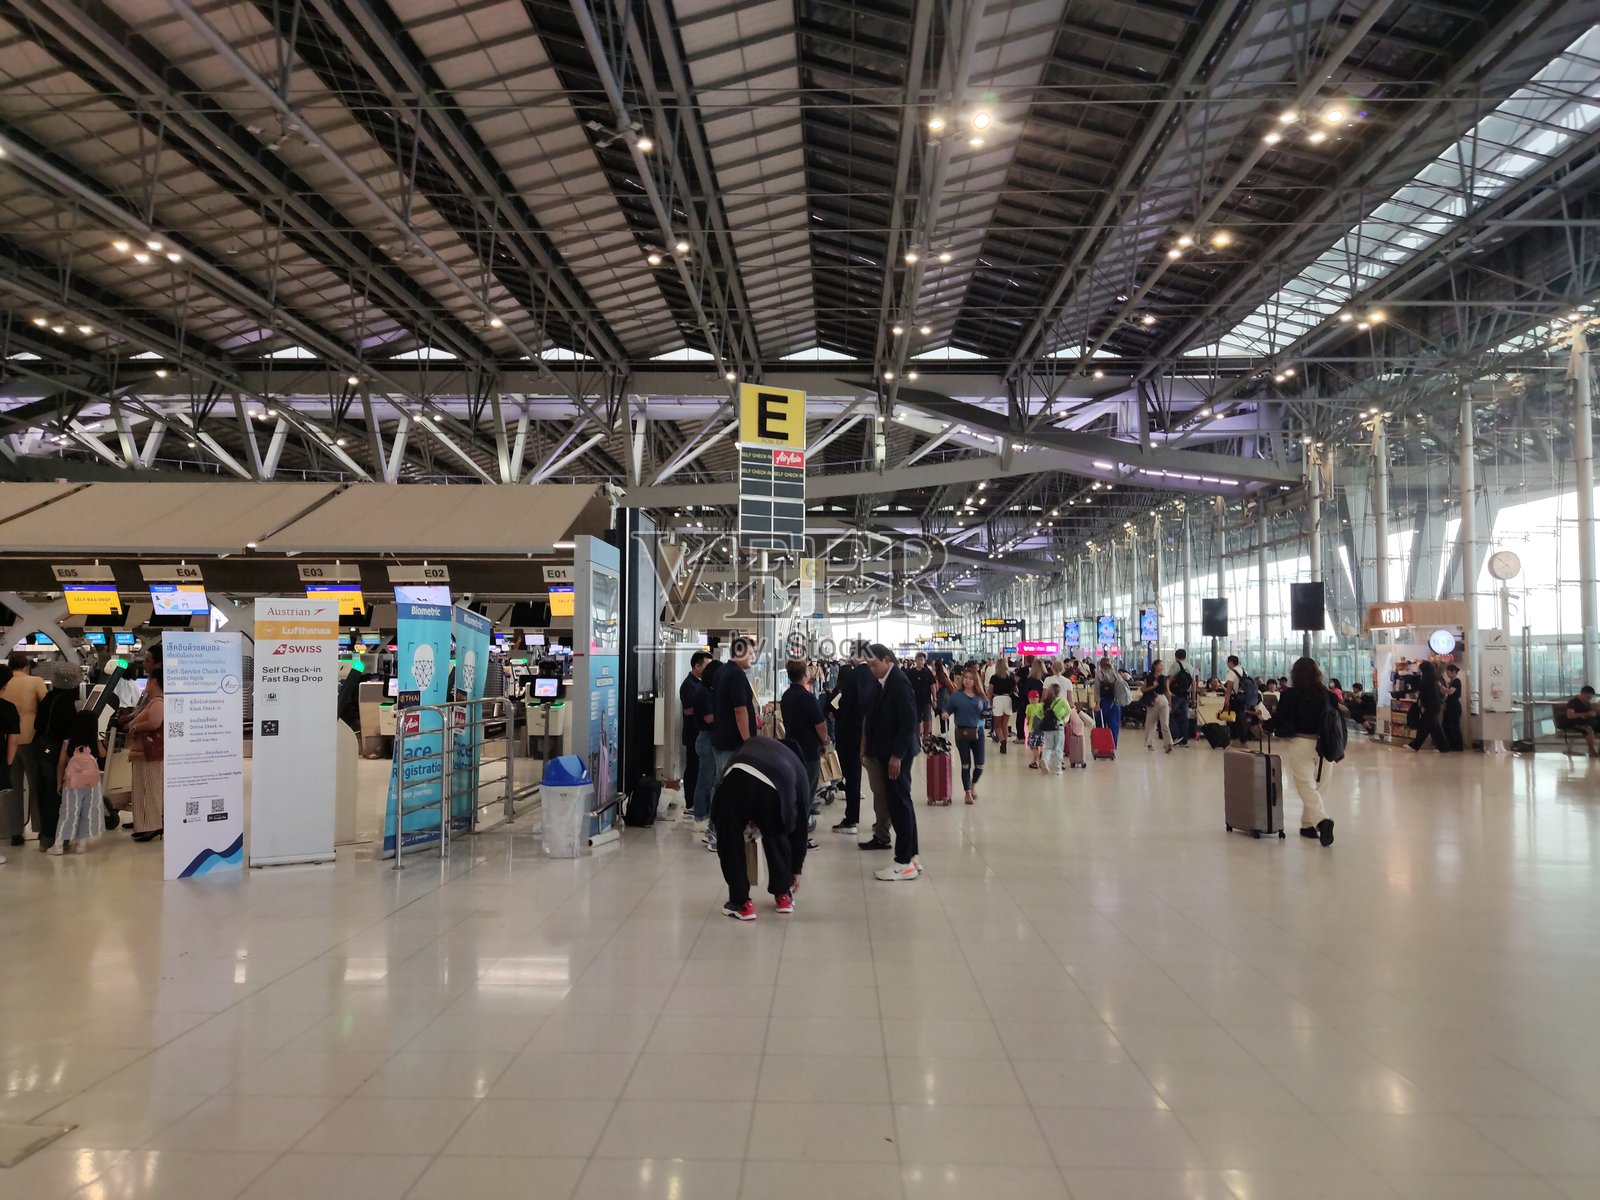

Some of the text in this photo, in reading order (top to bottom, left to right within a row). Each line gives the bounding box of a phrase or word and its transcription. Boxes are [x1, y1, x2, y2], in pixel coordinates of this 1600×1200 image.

[758, 393, 788, 440] E
[775, 451, 802, 465] AirAsia
[57, 569, 78, 578] E05
[176, 568, 198, 577] E04
[302, 568, 324, 577] E03
[424, 569, 445, 578] E02
[547, 569, 567, 578] E01
[267, 607, 311, 616] Austrian
[411, 605, 441, 616] Biometric
[1381, 607, 1403, 623] VENDI
[463, 613, 484, 630] Biometric
[281, 626, 331, 635] Lufthansa
[288, 645, 322, 654] SWISS
[262, 666, 321, 674] Self Check-in
[261, 674, 323, 684] Fast Bag Drop
[405, 694, 420, 702] THAI
